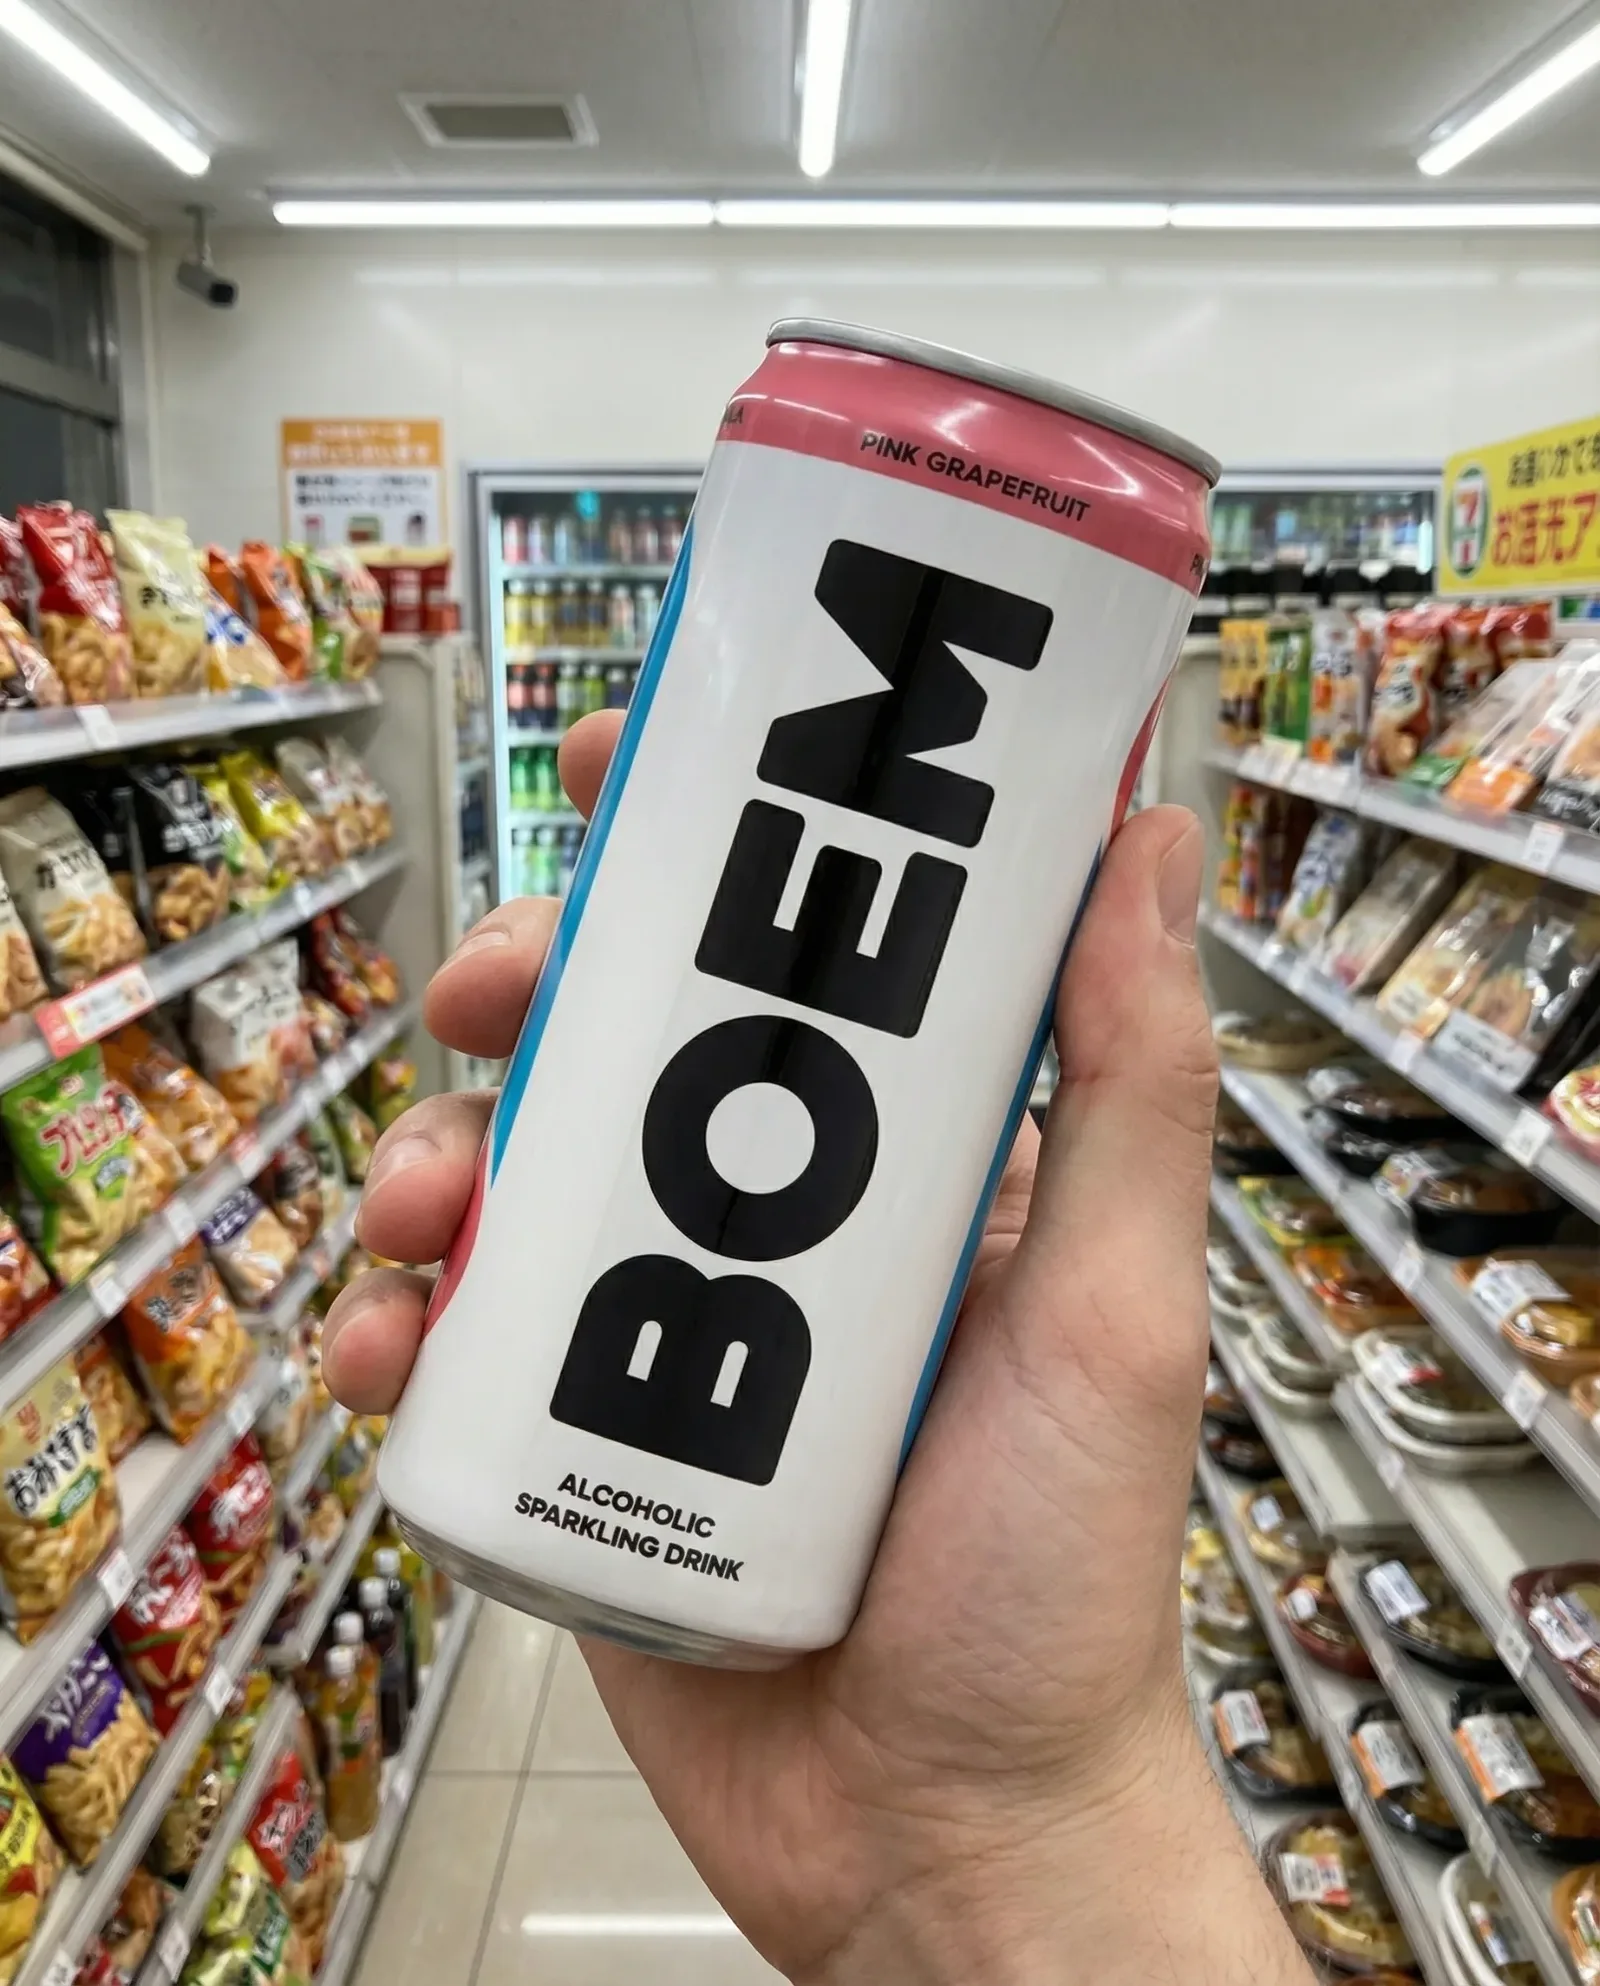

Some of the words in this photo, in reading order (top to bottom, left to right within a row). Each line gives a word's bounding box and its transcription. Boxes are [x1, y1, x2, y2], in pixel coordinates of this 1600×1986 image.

[860, 435, 922, 467] PINK
[926, 451, 1092, 522] GRAPEFRUIT
[550, 539, 1054, 1486] BOEM
[514, 1492, 660, 1559] SPARKLING
[663, 1542, 745, 1582] DRINK
[557, 1472, 716, 1538] ALCOHOLIC
